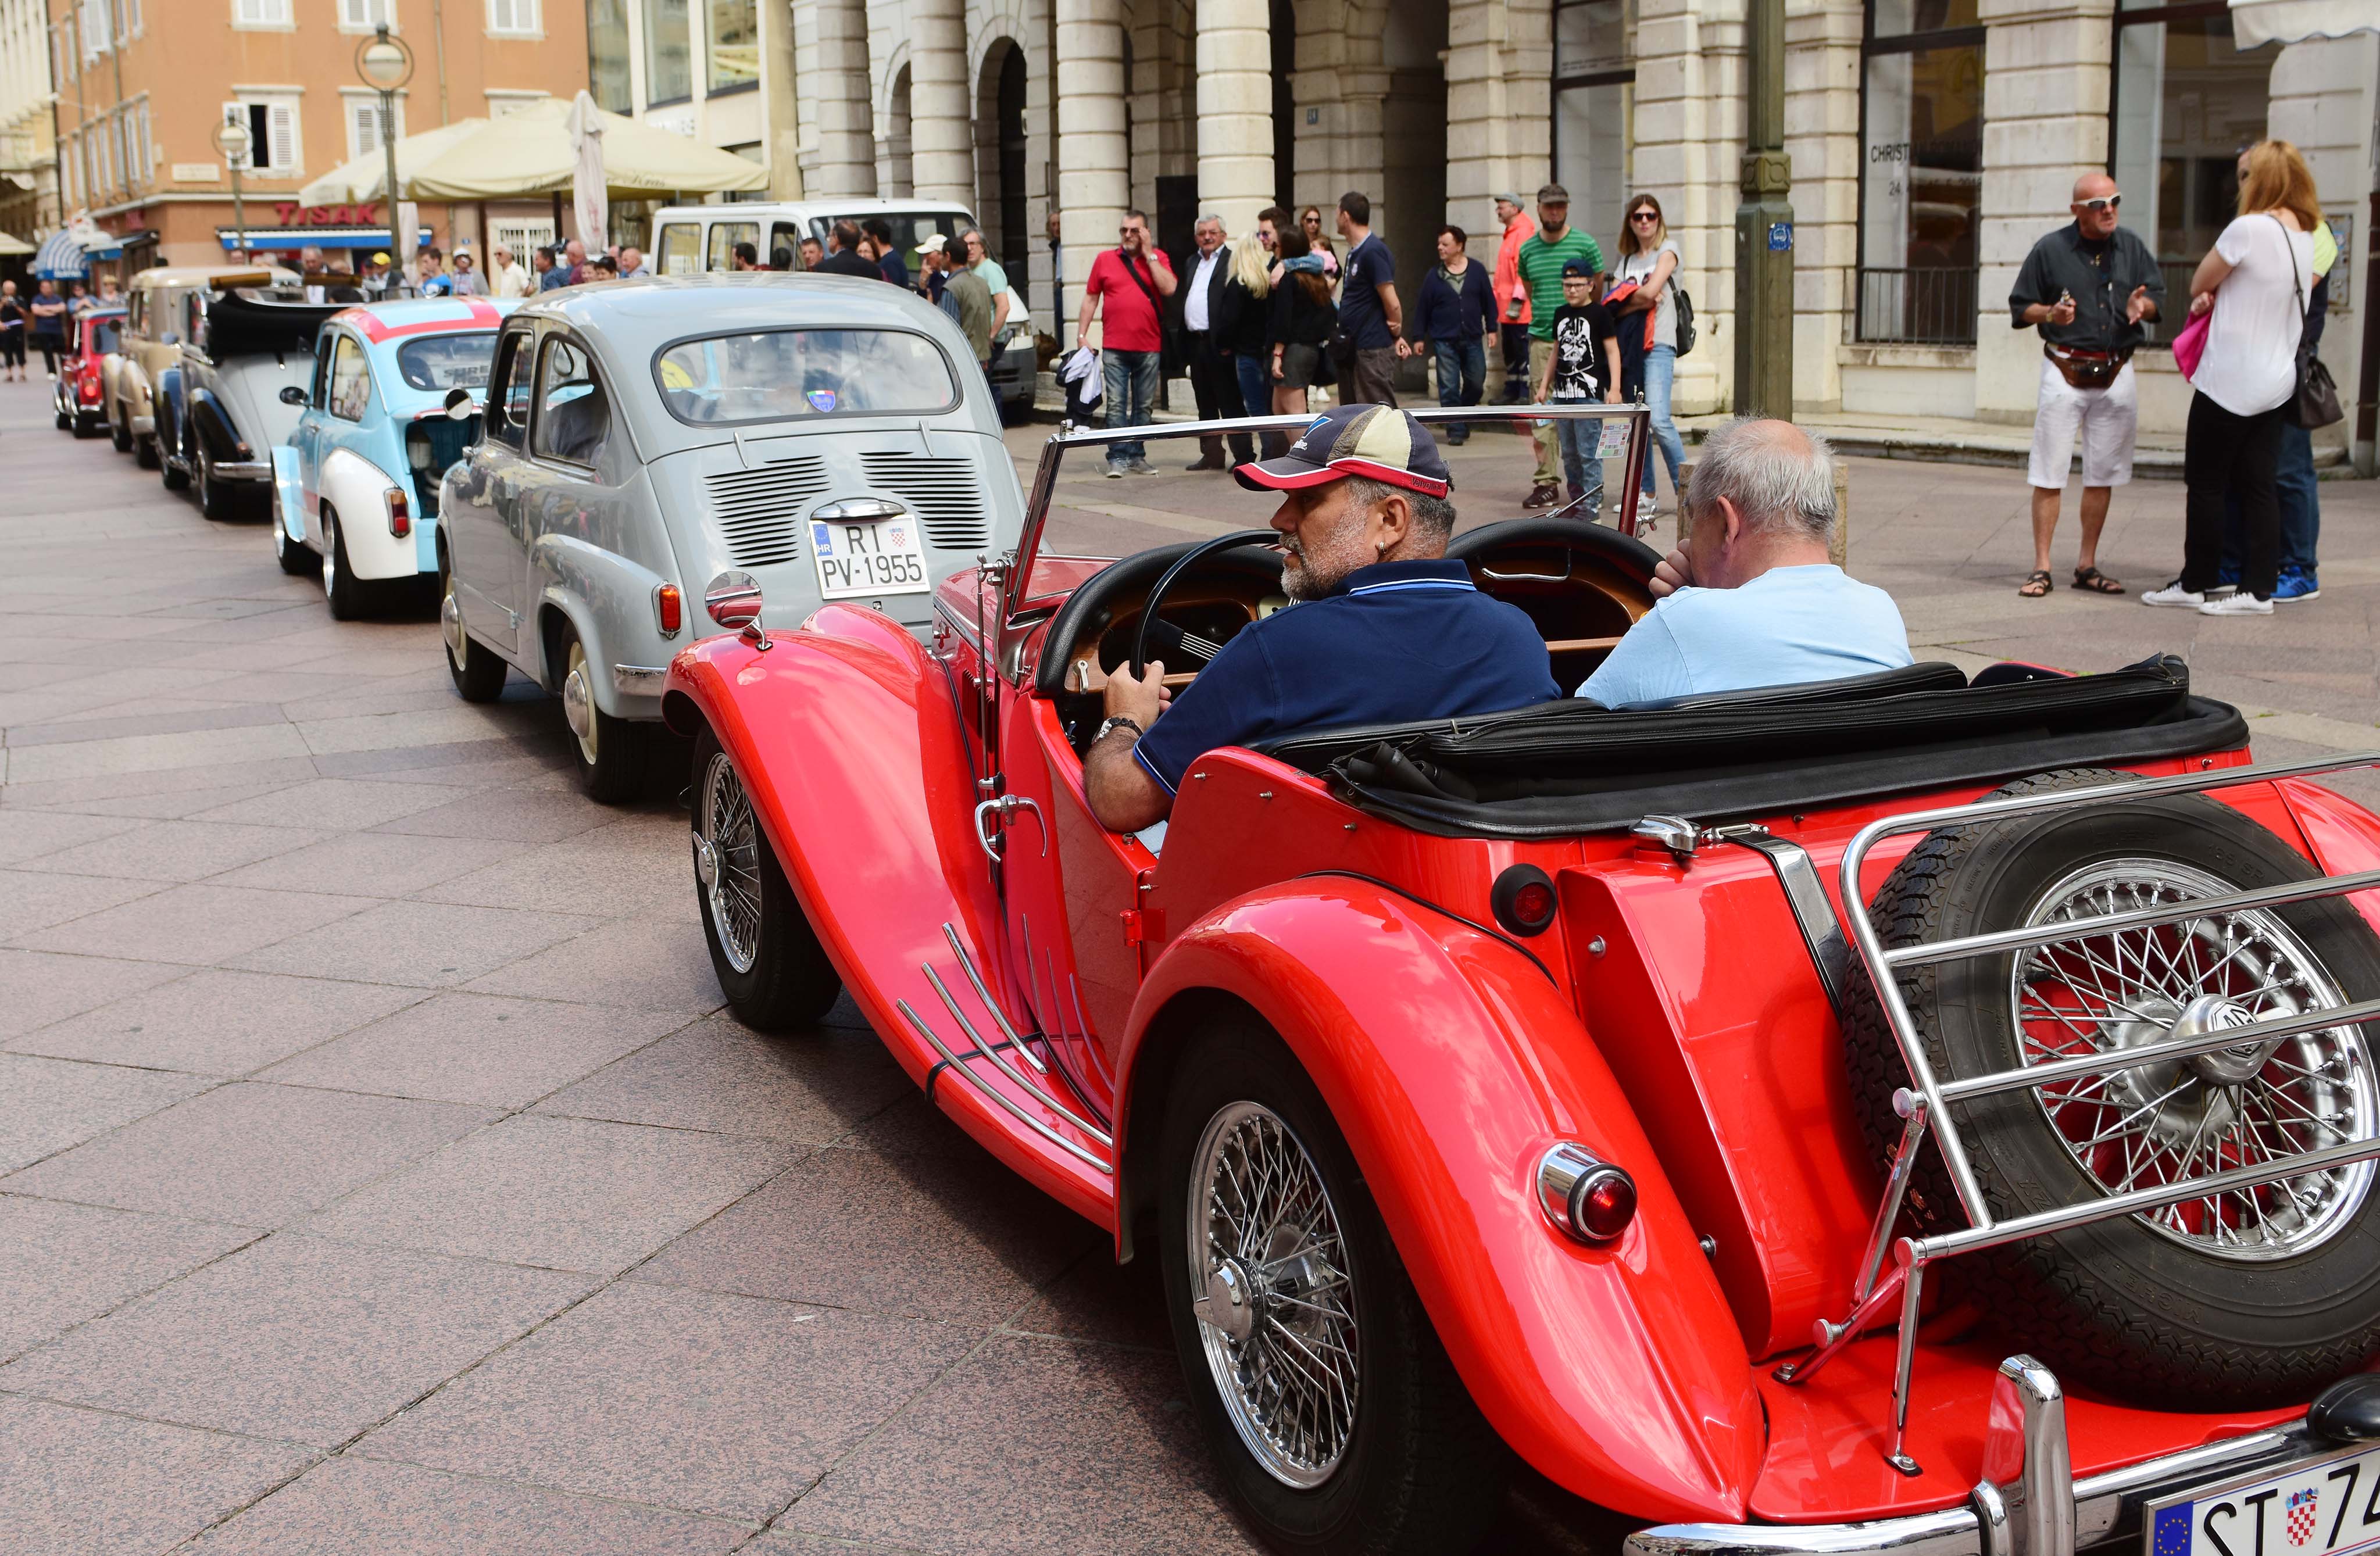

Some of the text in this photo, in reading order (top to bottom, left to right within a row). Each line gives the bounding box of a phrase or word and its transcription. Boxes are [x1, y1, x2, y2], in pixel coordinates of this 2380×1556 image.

[276, 203, 377, 225] TISAK
[817, 544, 831, 553] HR
[845, 525, 880, 554] RI
[821, 554, 923, 588] PV-1955
[2203, 1487, 2279, 1556] ST
